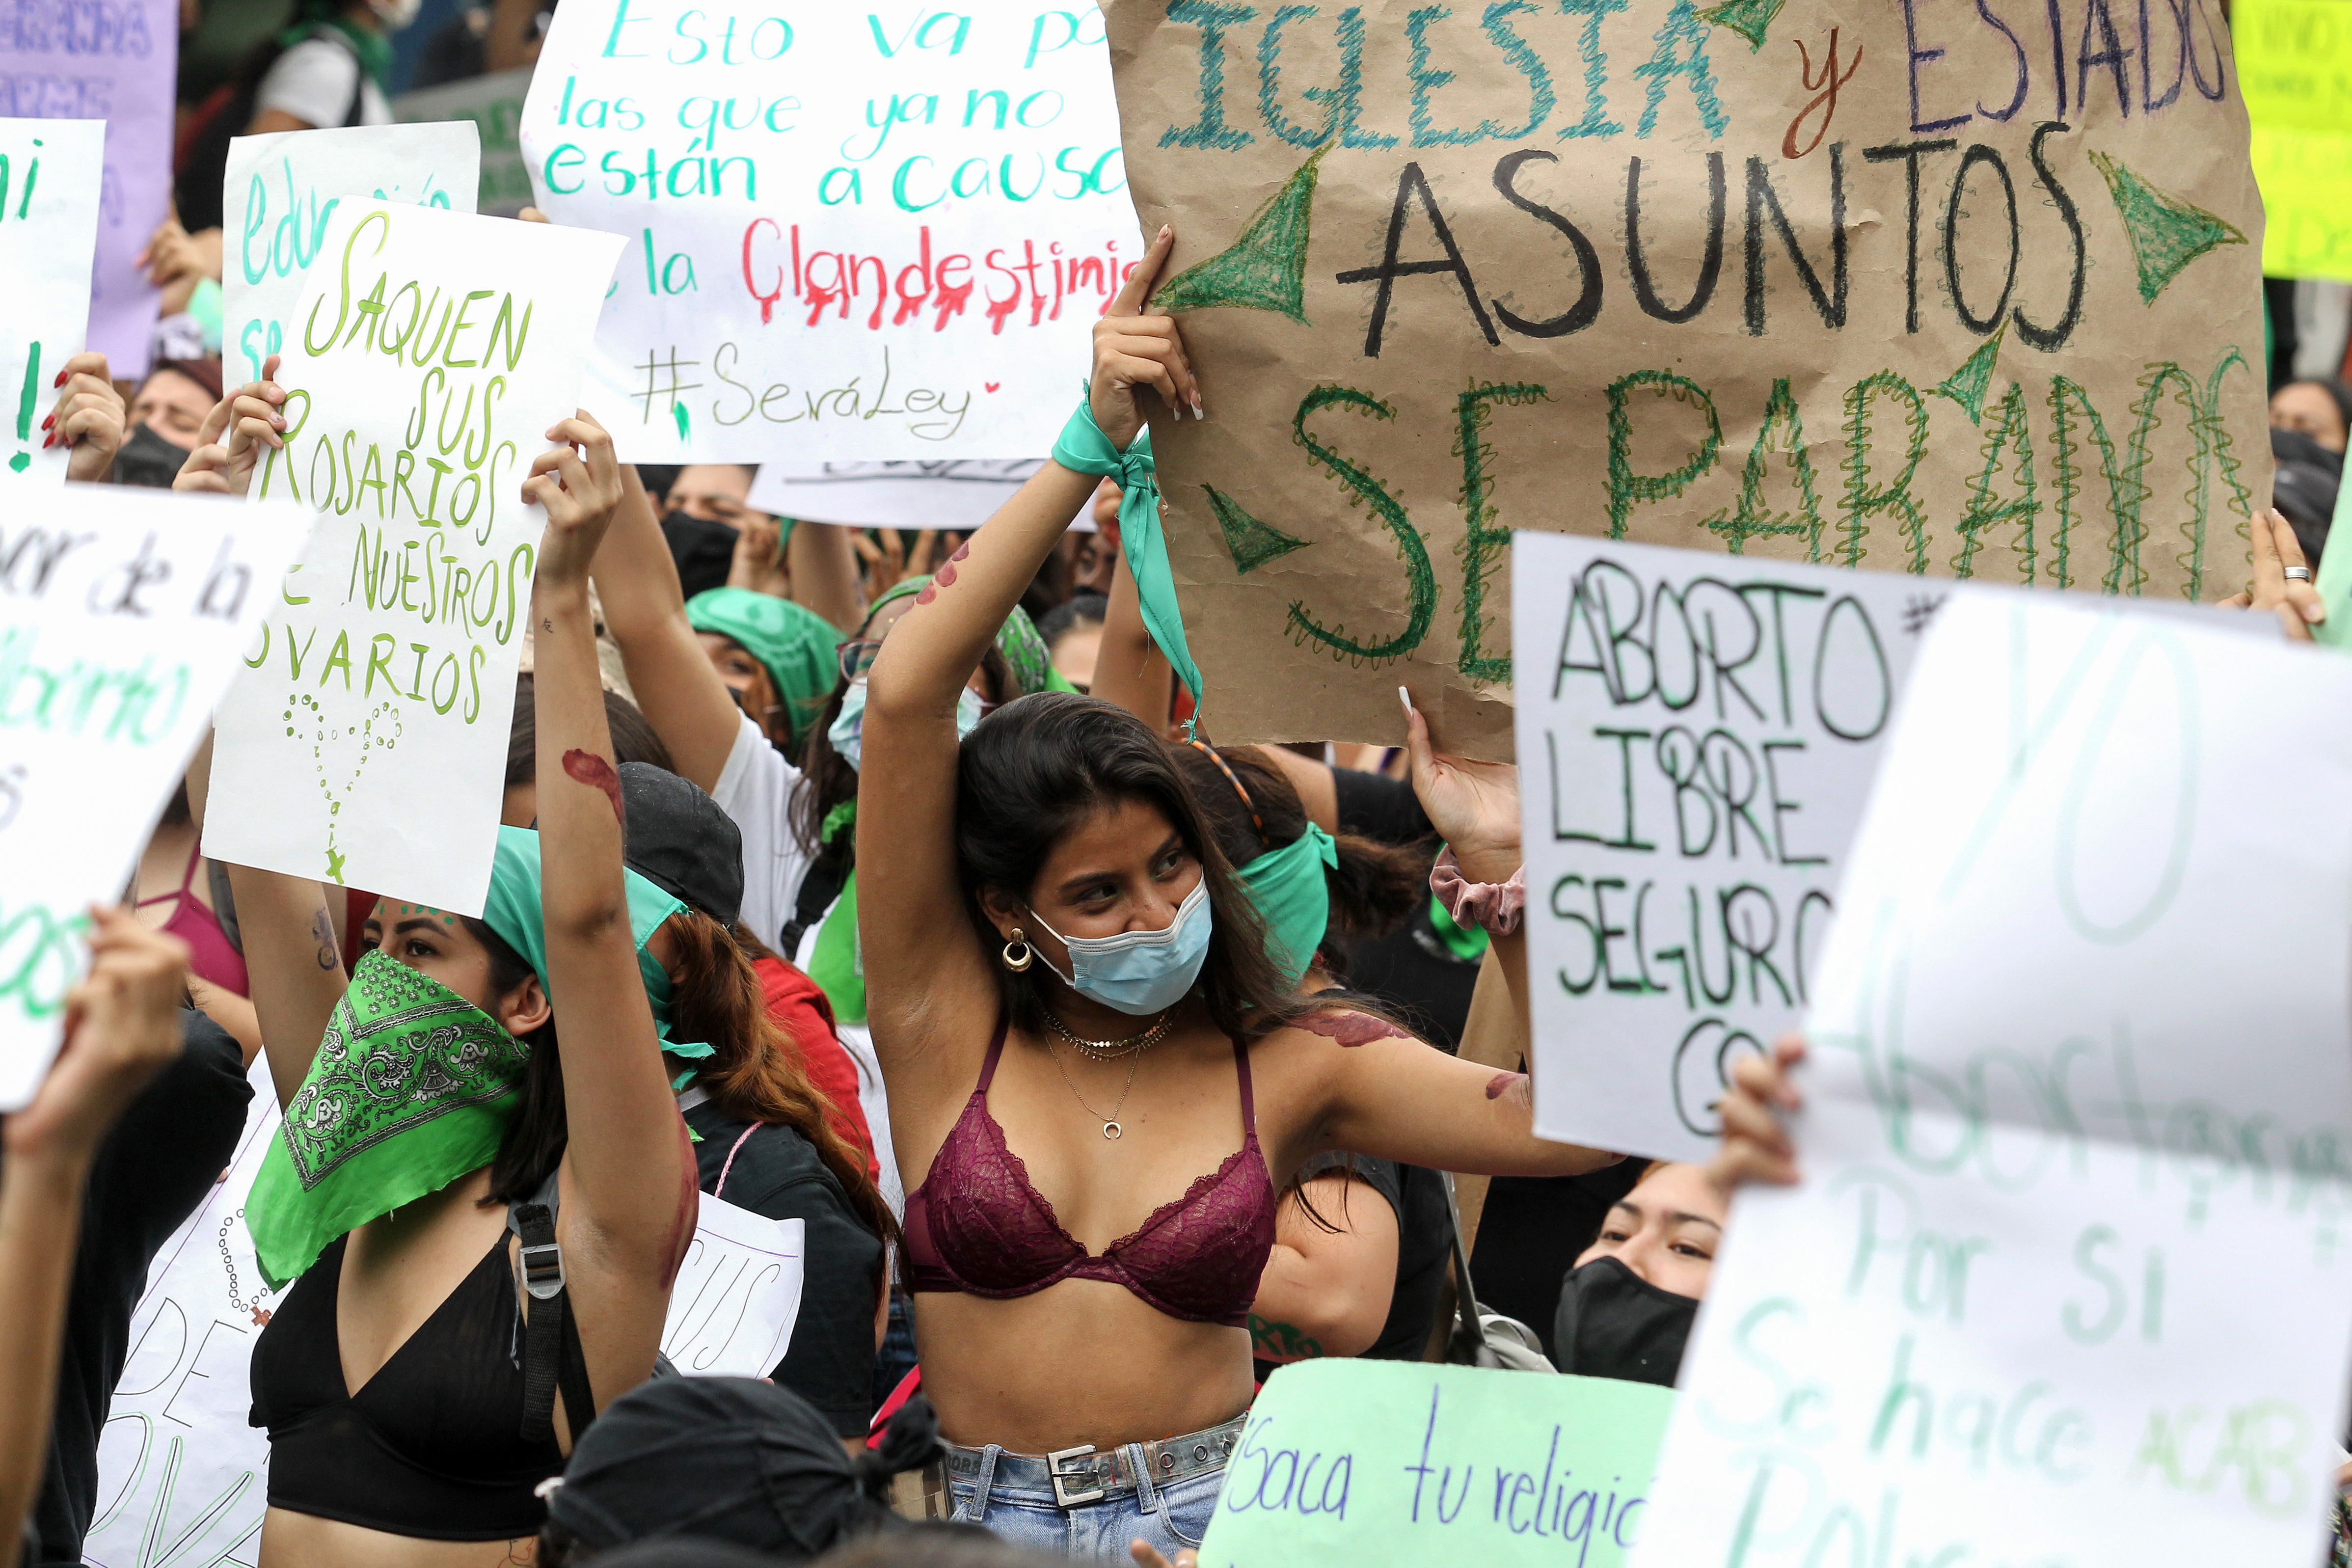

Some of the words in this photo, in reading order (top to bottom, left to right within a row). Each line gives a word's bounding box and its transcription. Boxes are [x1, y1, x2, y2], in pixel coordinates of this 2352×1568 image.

[601, 0, 794, 65] Esto
[867, 8, 972, 58] va
[1024, 6, 1106, 69] po
[1157, 0, 1731, 151] IGLESIA
[544, 136, 757, 202] están
[818, 166, 862, 206] a
[558, 75, 645, 132] las
[677, 95, 801, 152] que
[304, 210, 533, 372] SAQUEN
[643, 228, 698, 295] la
[743, 217, 1139, 333] Clandestini
[1336, 121, 2086, 357] ASUNTOS
[259, 389, 516, 546] ROSARIOS
[406, 366, 506, 470] SUS
[349, 523, 534, 646] NUESTROS
[1552, 558, 1893, 742] ABORTO
[1546, 725, 1829, 866] LIBRE
[1404, 1383, 1473, 1524] tu
[1867, 1328, 2095, 1485] hace
